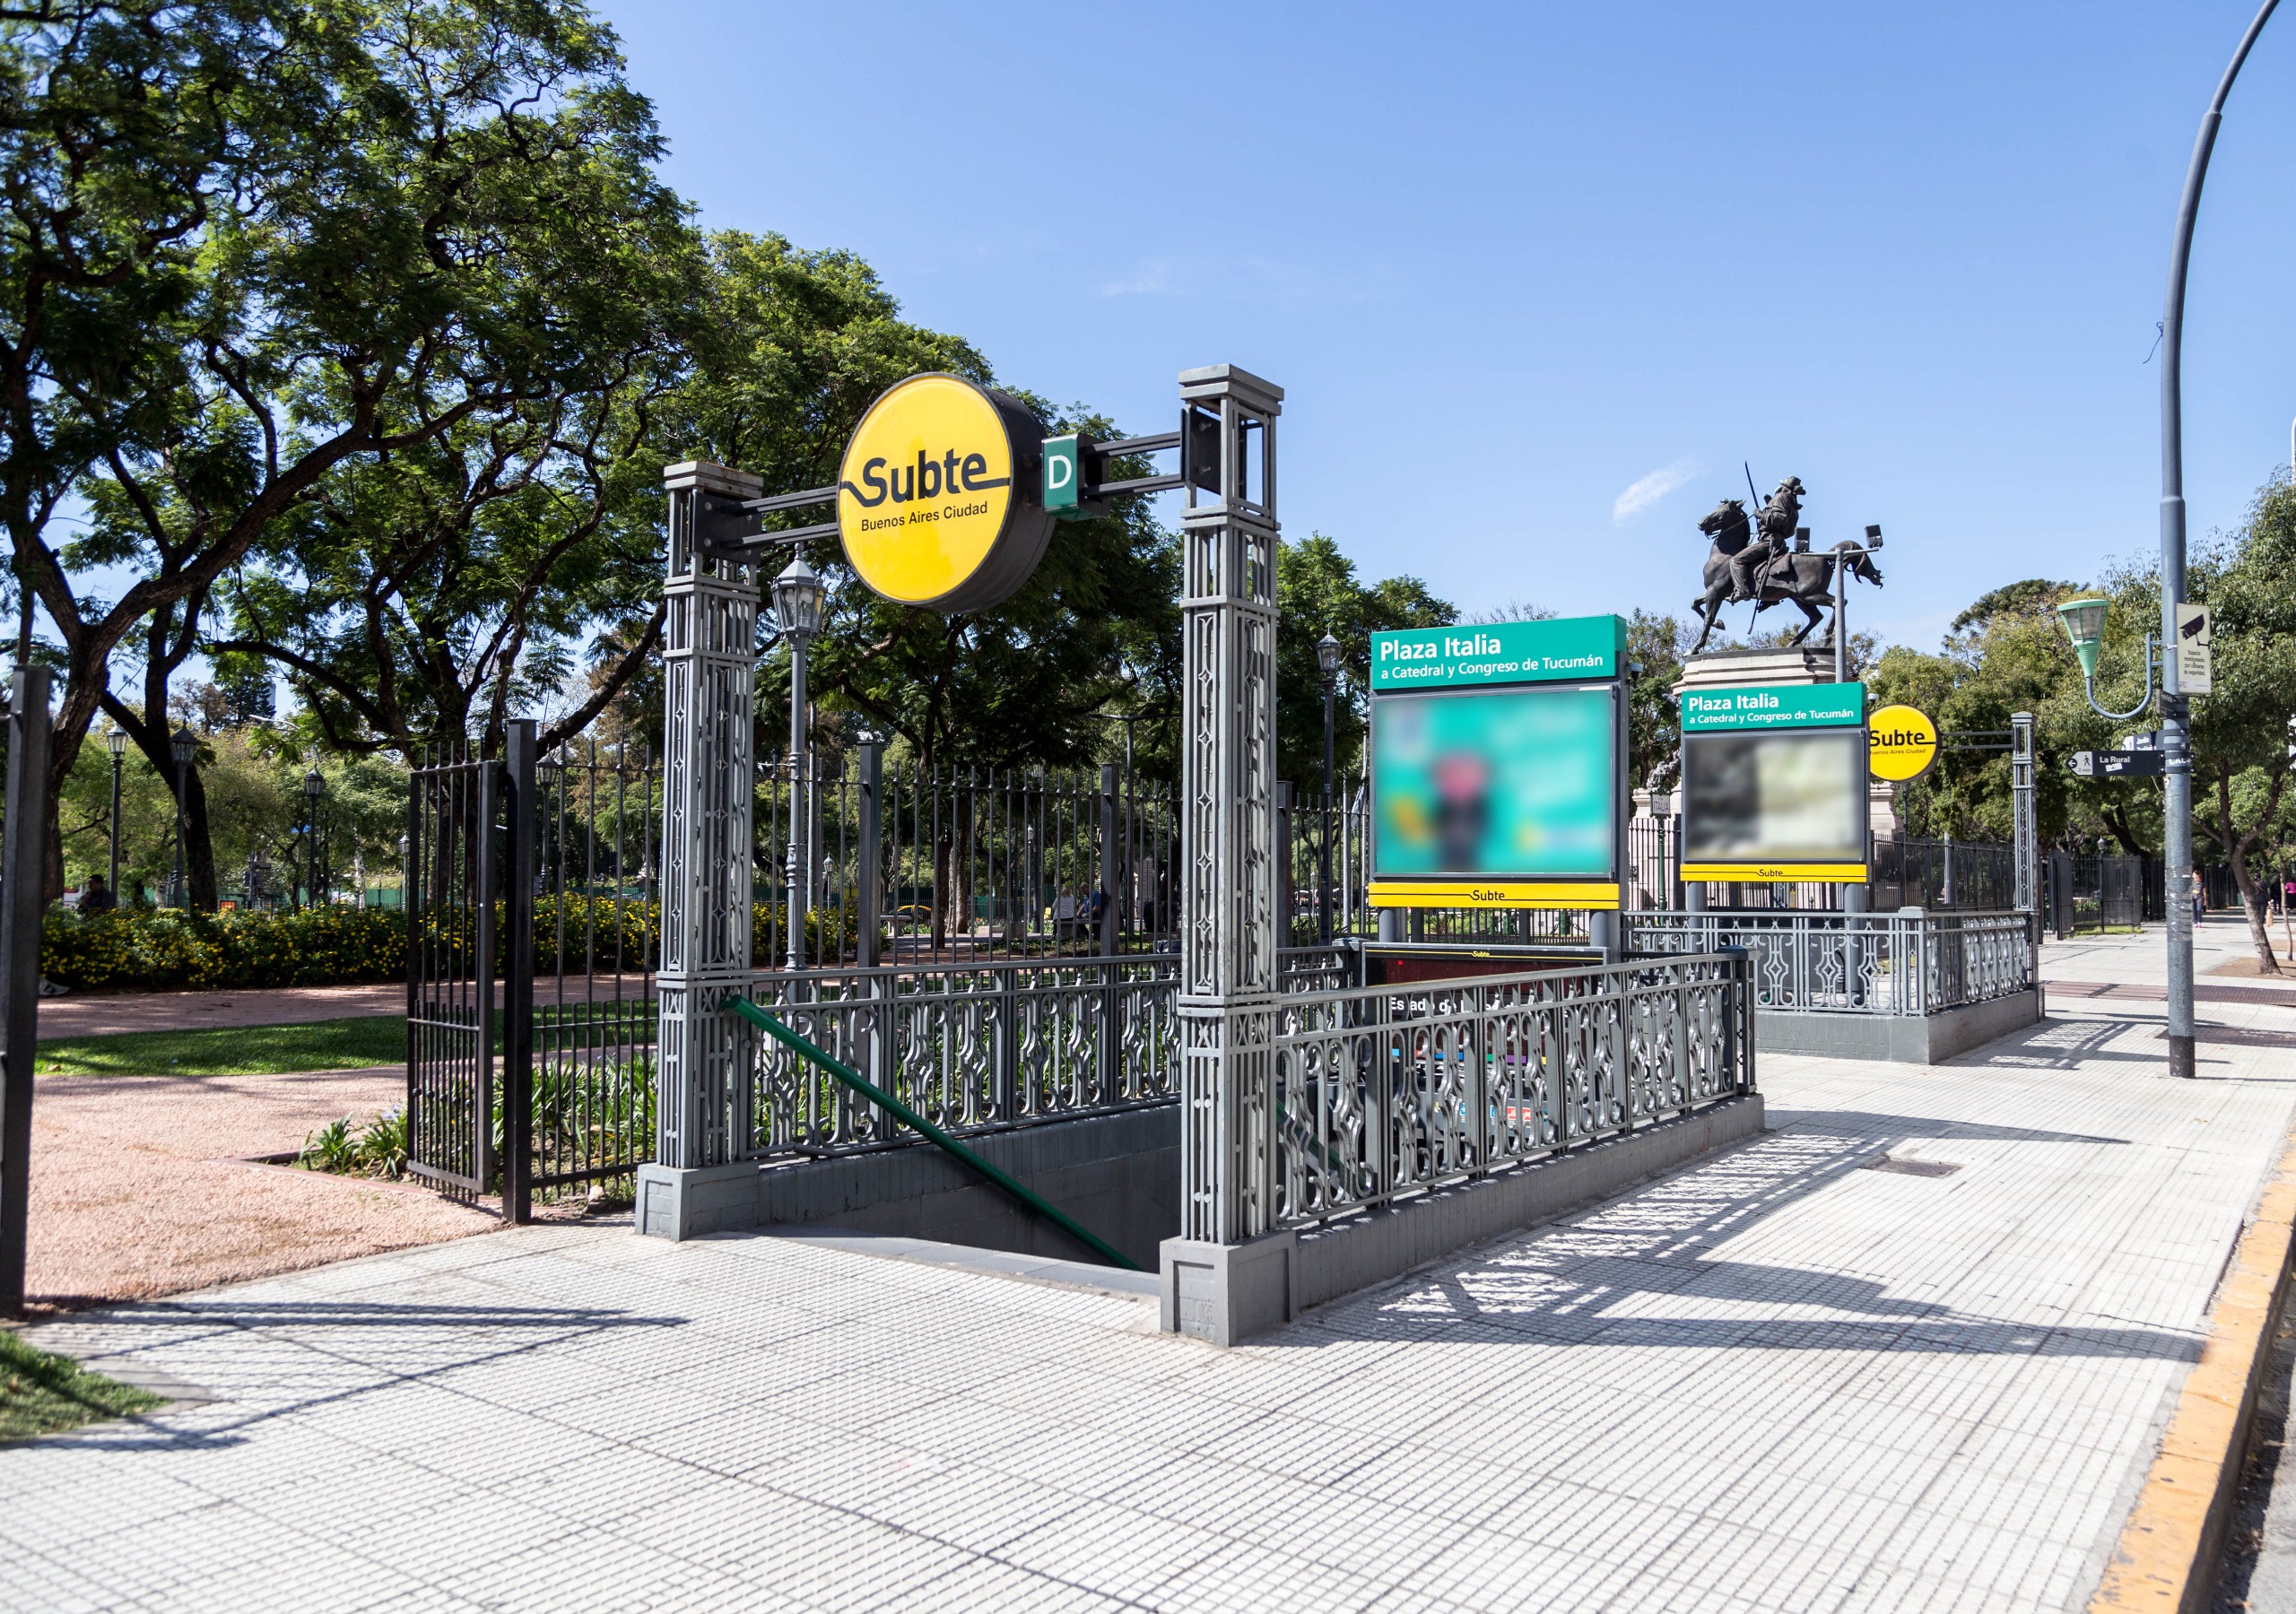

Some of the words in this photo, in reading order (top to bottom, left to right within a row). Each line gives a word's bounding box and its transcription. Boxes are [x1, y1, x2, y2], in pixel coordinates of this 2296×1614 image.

[857, 448, 987, 508] Subte
[1048, 455, 1072, 490] D
[861, 516, 905, 532] Buenos
[909, 510, 939, 525] Aires
[944, 501, 987, 519] Ciudad
[1381, 639, 1437, 661] Plaza
[1445, 634, 1500, 657] Italia
[1381, 670, 1388, 679] a
[1392, 664, 1444, 679] Catedral
[1448, 666, 1455, 679] y
[1458, 662, 1518, 676] Congreso
[1522, 658, 1538, 671] de
[1542, 654, 1603, 670] Tucumán
[1689, 696, 1731, 711] Plaza
[1736, 693, 1779, 708] Italia
[1698, 714, 1736, 724] Catedral
[1739, 715, 1744, 724] y
[1747, 712, 1792, 724] Congreso
[1795, 711, 1807, 720] de
[1809, 708, 1854, 719] Tucumán
[1870, 729, 1926, 747] Subte
[1759, 868, 1784, 877] Subte
[1473, 889, 1506, 901] Subte
